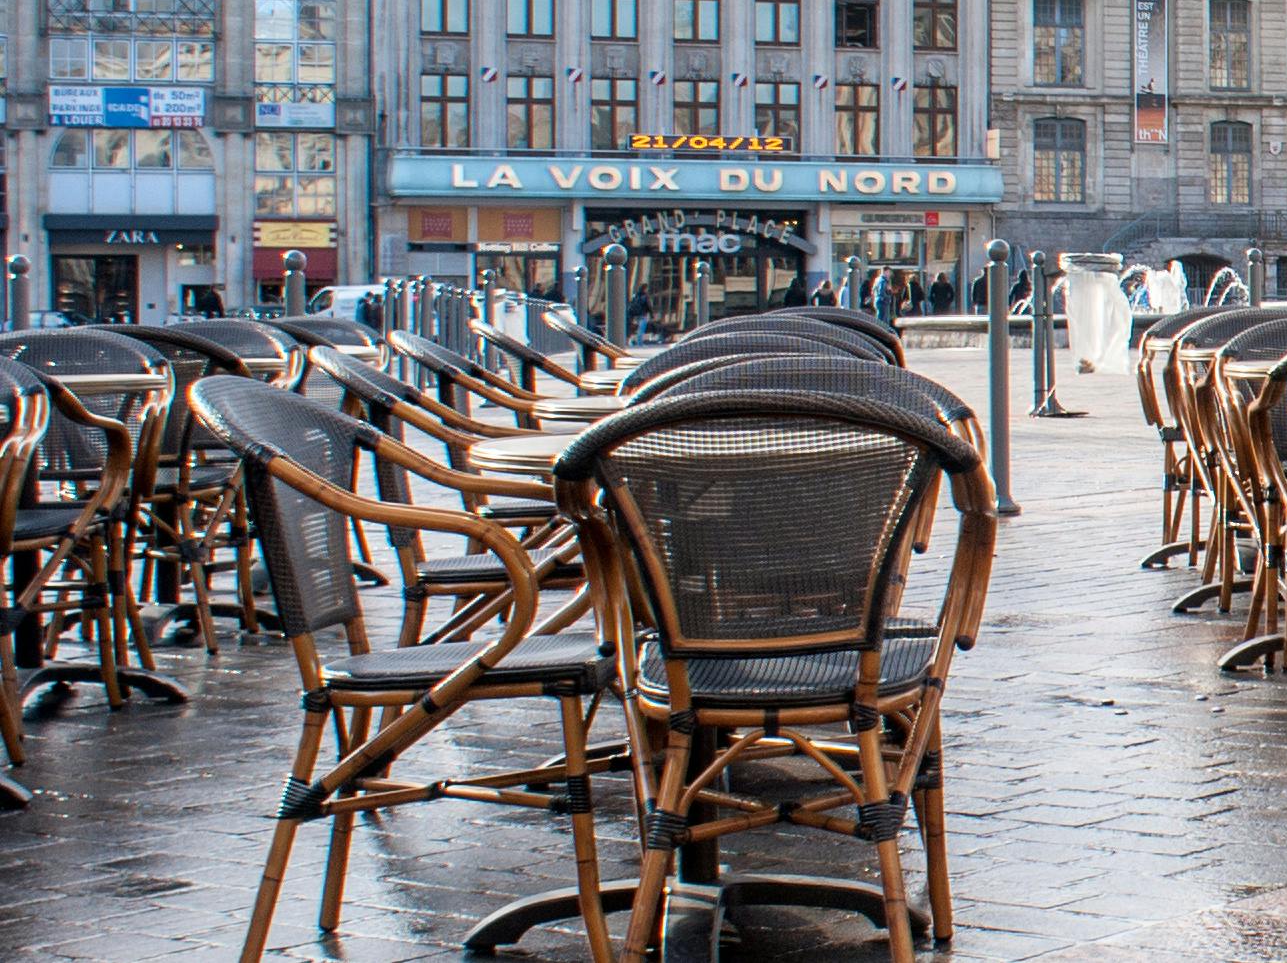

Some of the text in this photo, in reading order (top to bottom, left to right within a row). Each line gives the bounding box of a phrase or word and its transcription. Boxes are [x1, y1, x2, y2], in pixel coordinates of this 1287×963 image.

[1137, 1, 1153, 12] EST
[1137, 12, 1151, 20] UN
[65, 115, 104, 126] LOUER
[632, 134, 784, 151] 21/04/12
[451, 163, 957, 195] LA VOIX DU NORD
[716, 209, 796, 245] PLACE
[104, 229, 159, 244] ZARA
[657, 228, 742, 254] fnac
